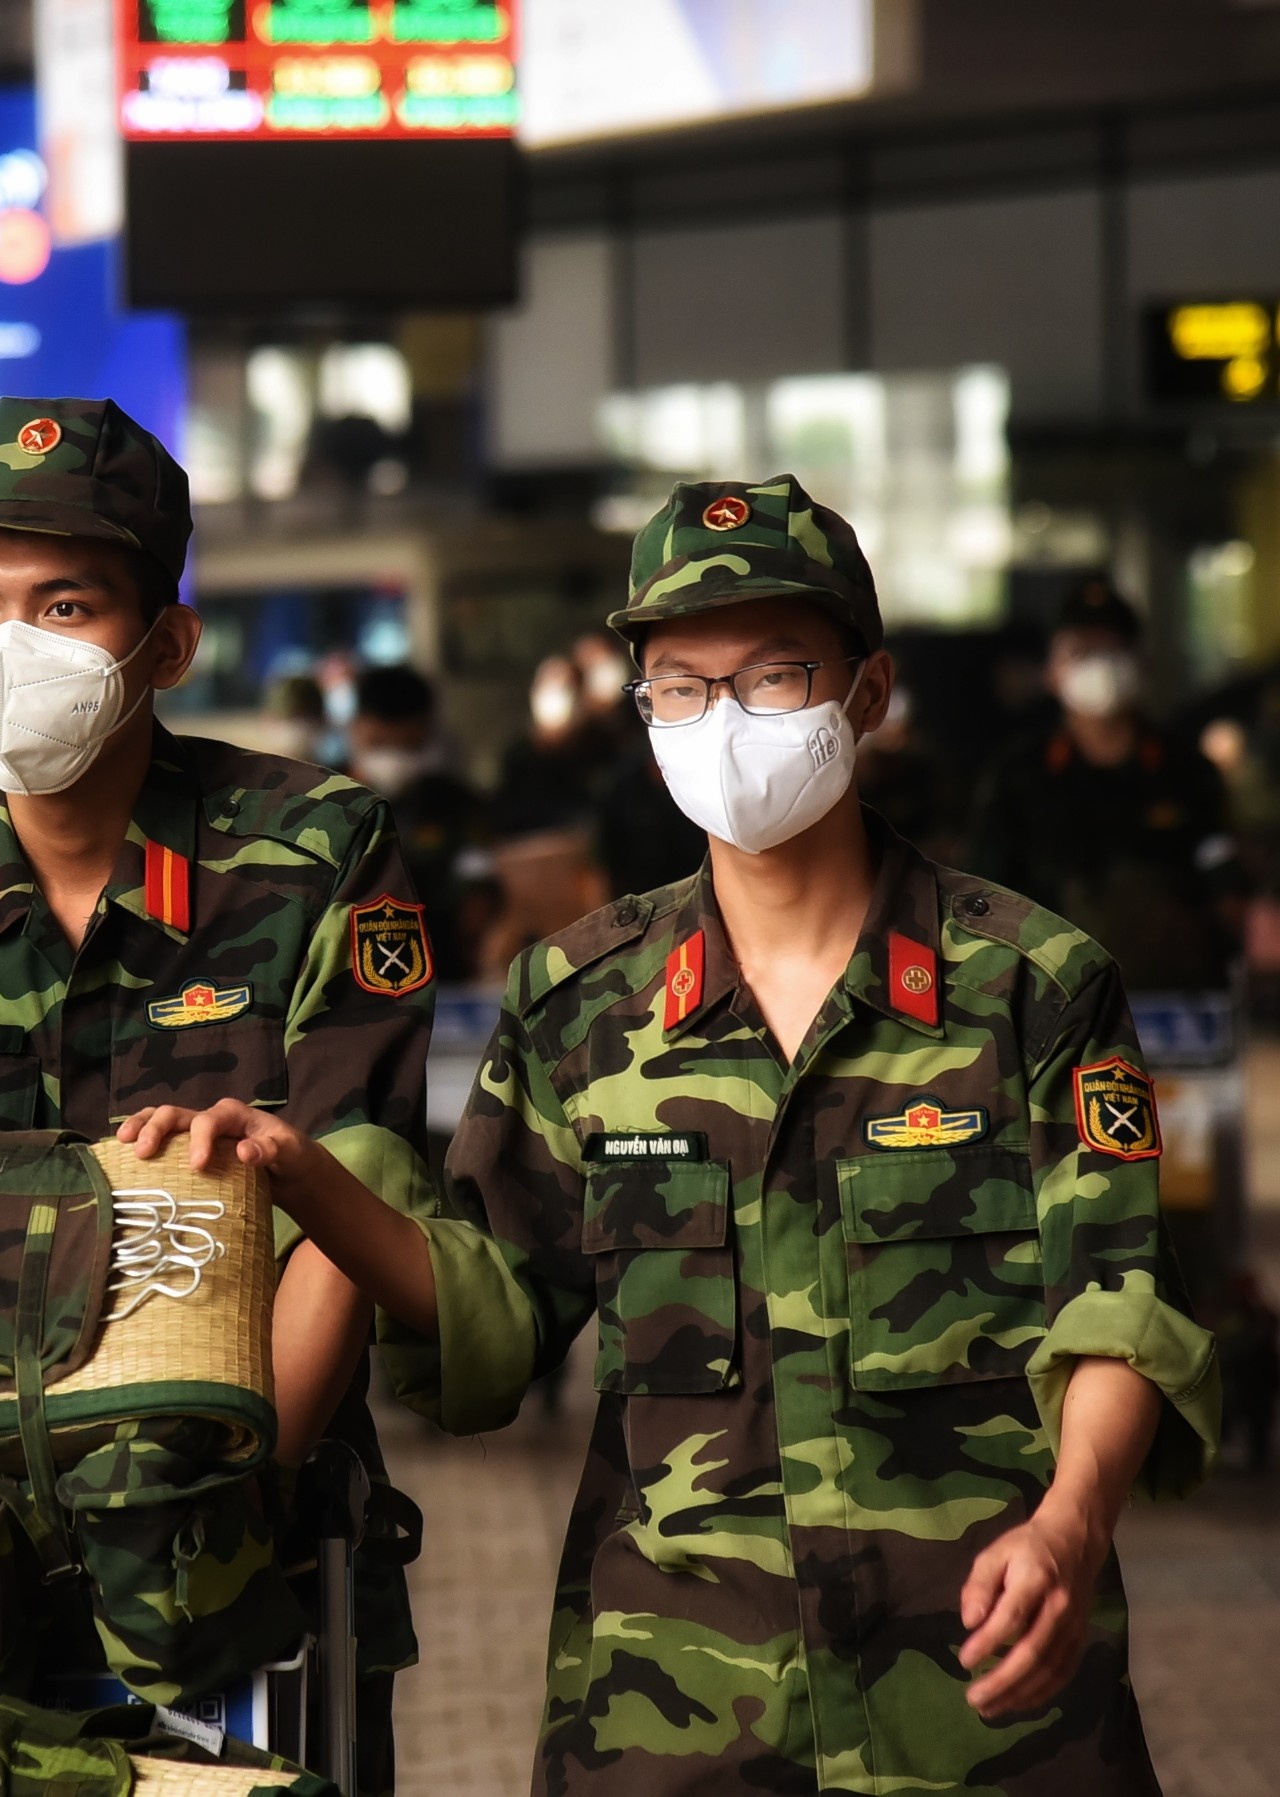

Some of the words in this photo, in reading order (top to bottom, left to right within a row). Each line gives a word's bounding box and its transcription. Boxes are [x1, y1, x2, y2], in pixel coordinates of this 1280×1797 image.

[71, 701, 99, 714] AN95
[359, 919, 378, 933] QUÂN
[375, 930, 392, 943] VIỆT
[393, 931, 407, 941] NAM
[1084, 1079, 1106, 1092] QUÂN
[1102, 1093, 1120, 1103] VIỆT
[1122, 1095, 1139, 1106] NAM
[604, 1135, 647, 1155] NGUYỄN
[649, 1137, 672, 1155] VĂN
[672, 1138, 689, 1157] ĐẠI
